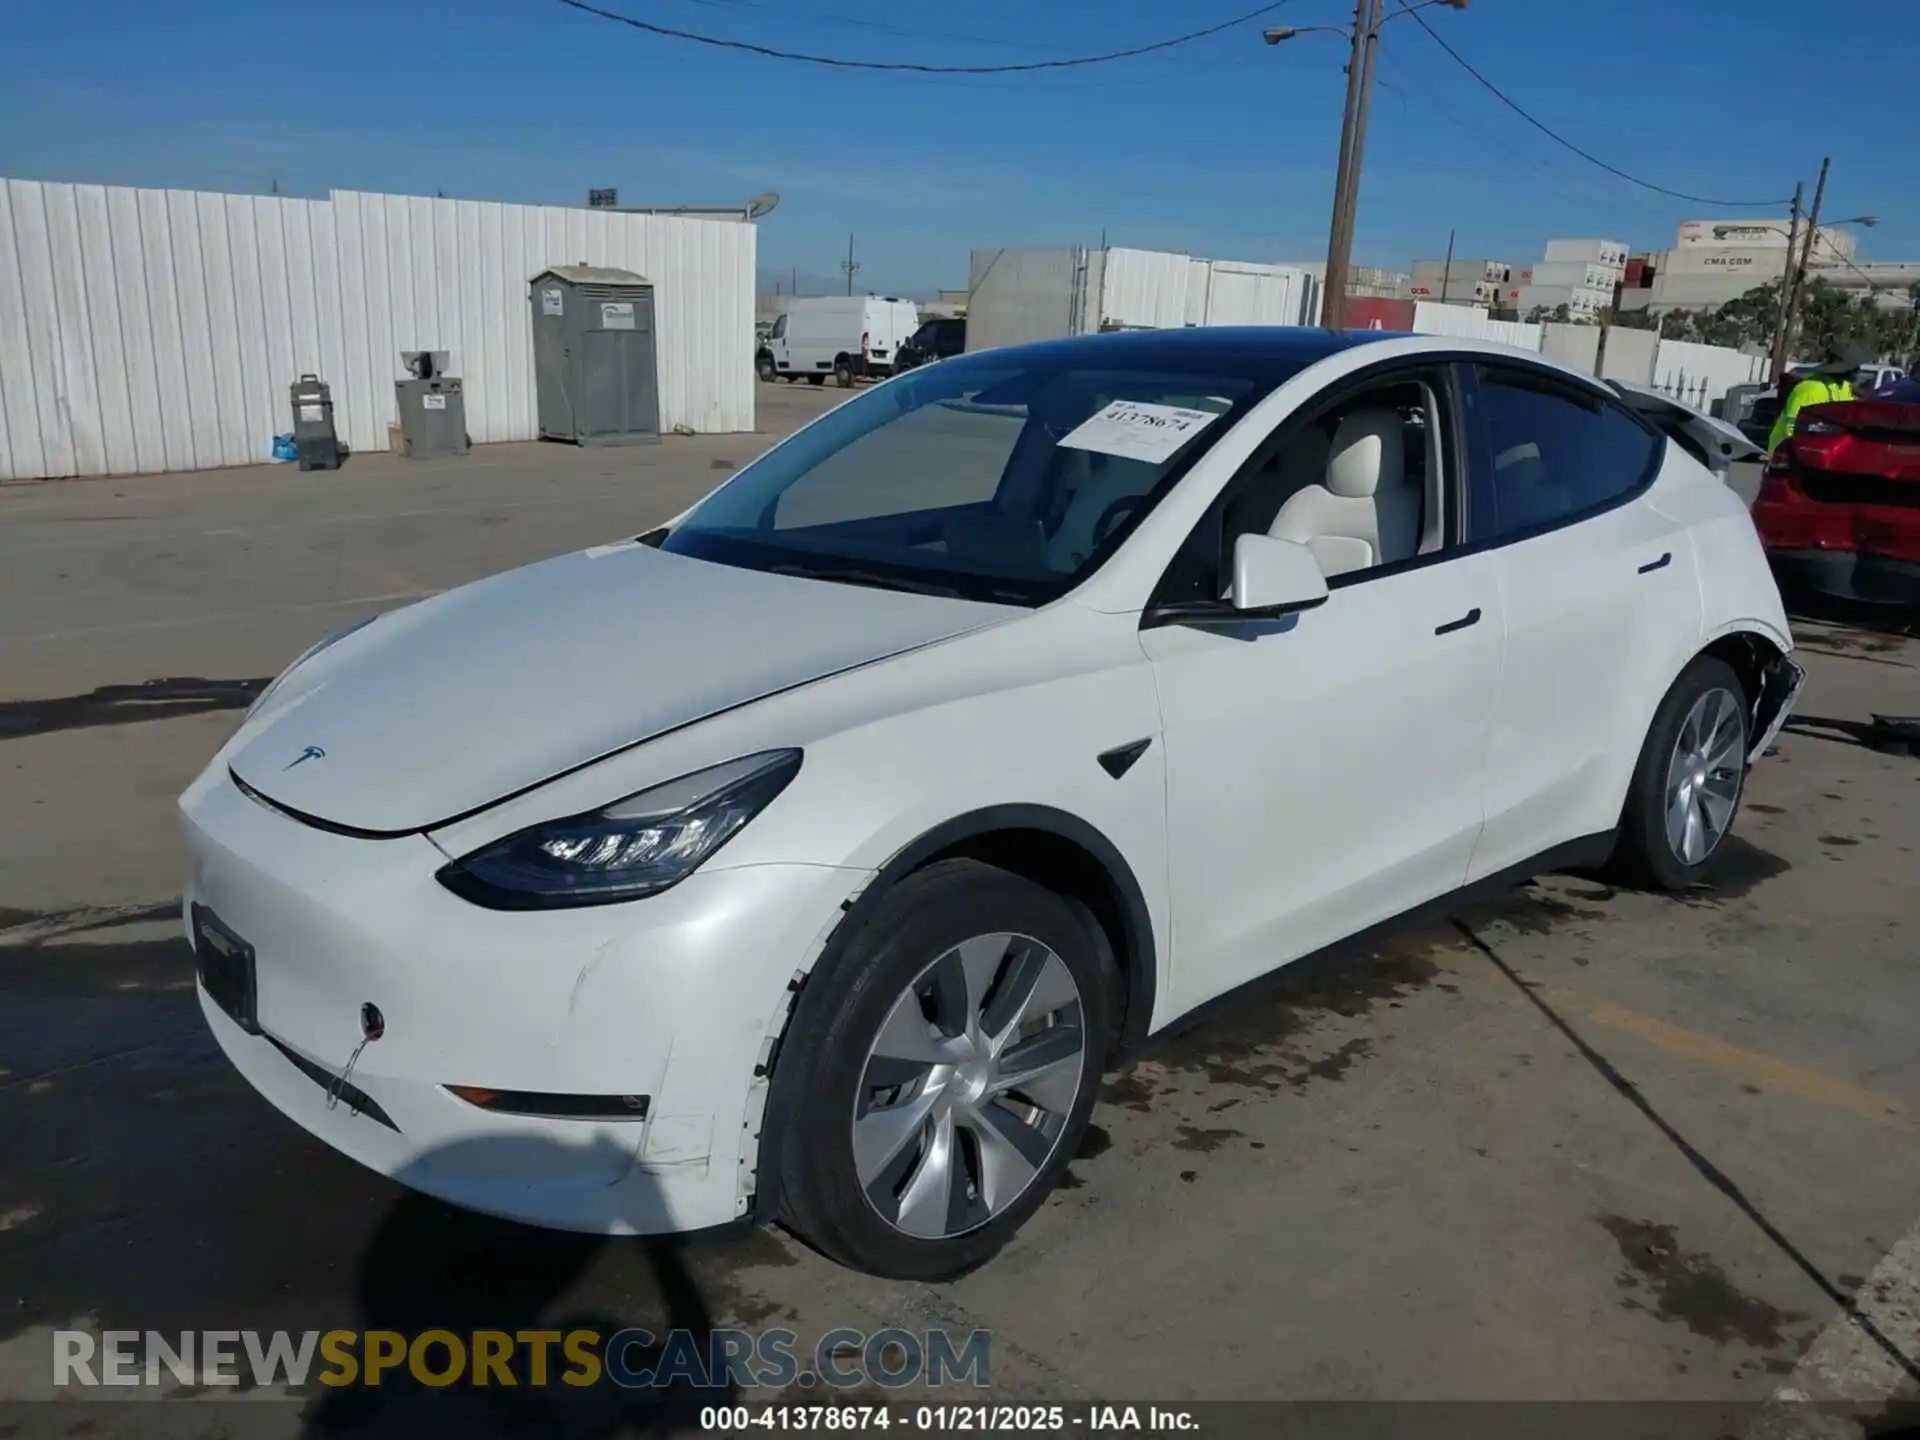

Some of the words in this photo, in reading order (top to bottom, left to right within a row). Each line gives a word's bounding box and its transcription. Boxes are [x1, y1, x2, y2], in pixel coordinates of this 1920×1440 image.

[1703, 257, 1727, 266] CMA
[1728, 257, 1752, 265] CGM
[1106, 411, 1190, 431] 41378674
